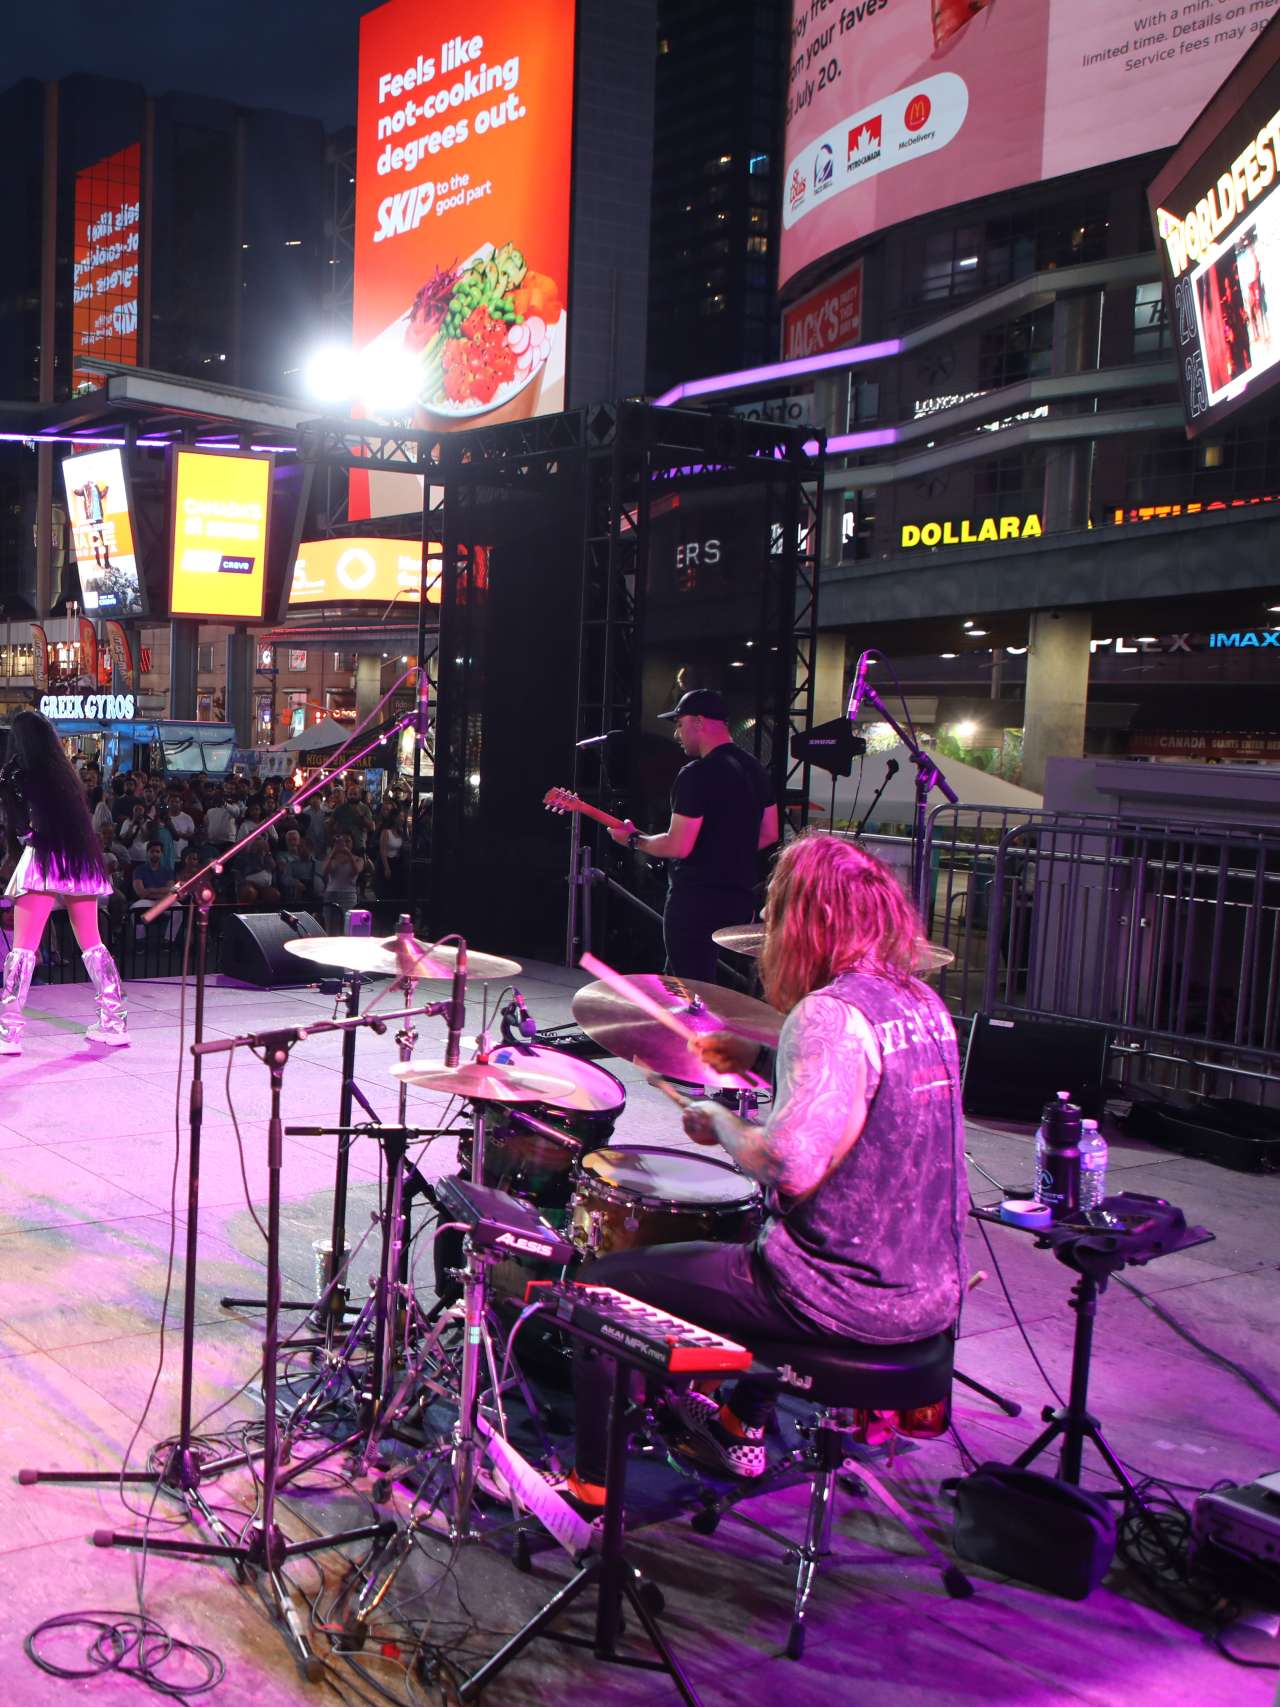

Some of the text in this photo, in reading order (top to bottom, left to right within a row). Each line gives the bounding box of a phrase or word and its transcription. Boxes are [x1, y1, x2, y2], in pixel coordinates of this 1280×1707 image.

[806, 23, 836, 70] your
[839, 0, 888, 36] faves
[1082, 42, 1129, 67] limited
[1133, 33, 1168, 51] time.
[1172, 13, 1221, 38] Details
[1225, 7, 1244, 20] on
[1134, 11, 1167, 32] With
[1170, 9, 1178, 19] a
[1125, 47, 1175, 72] Service
[1179, 36, 1210, 55] fees
[1214, 24, 1246, 43] may
[378, 35, 483, 104] Feels like
[818, 58, 842, 92] 20.
[377, 56, 520, 140] not-cooking
[376, 92, 527, 176] degrees out.
[898, 131, 935, 151] McDelivery
[436, 173, 469, 195] to the
[436, 180, 492, 216] good part
[373, 181, 436, 243] SKIP
[1209, 631, 1280, 648] IMAX
[40, 695, 135, 720] GREEK GYROS
[495, 1233, 553, 1257] ALESIS
